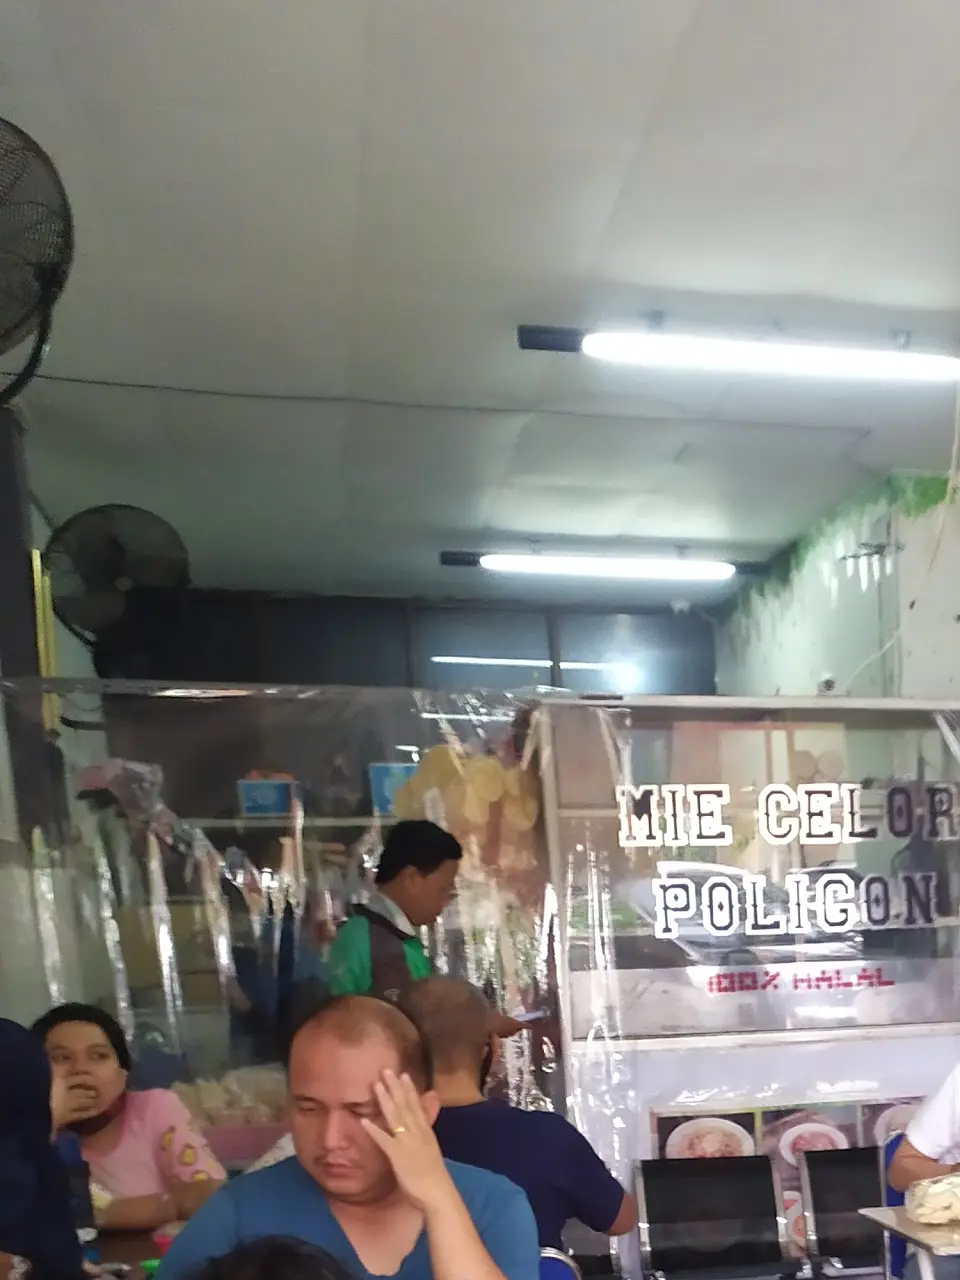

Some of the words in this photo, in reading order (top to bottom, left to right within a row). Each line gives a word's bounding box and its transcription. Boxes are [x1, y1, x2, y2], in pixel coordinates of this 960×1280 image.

[616, 783, 733, 847] MIE
[757, 783, 960, 844] CELOR
[652, 873, 939, 939] POLIGON
[707, 971, 781, 994] 100%
[792, 967, 896, 991] HALAL
